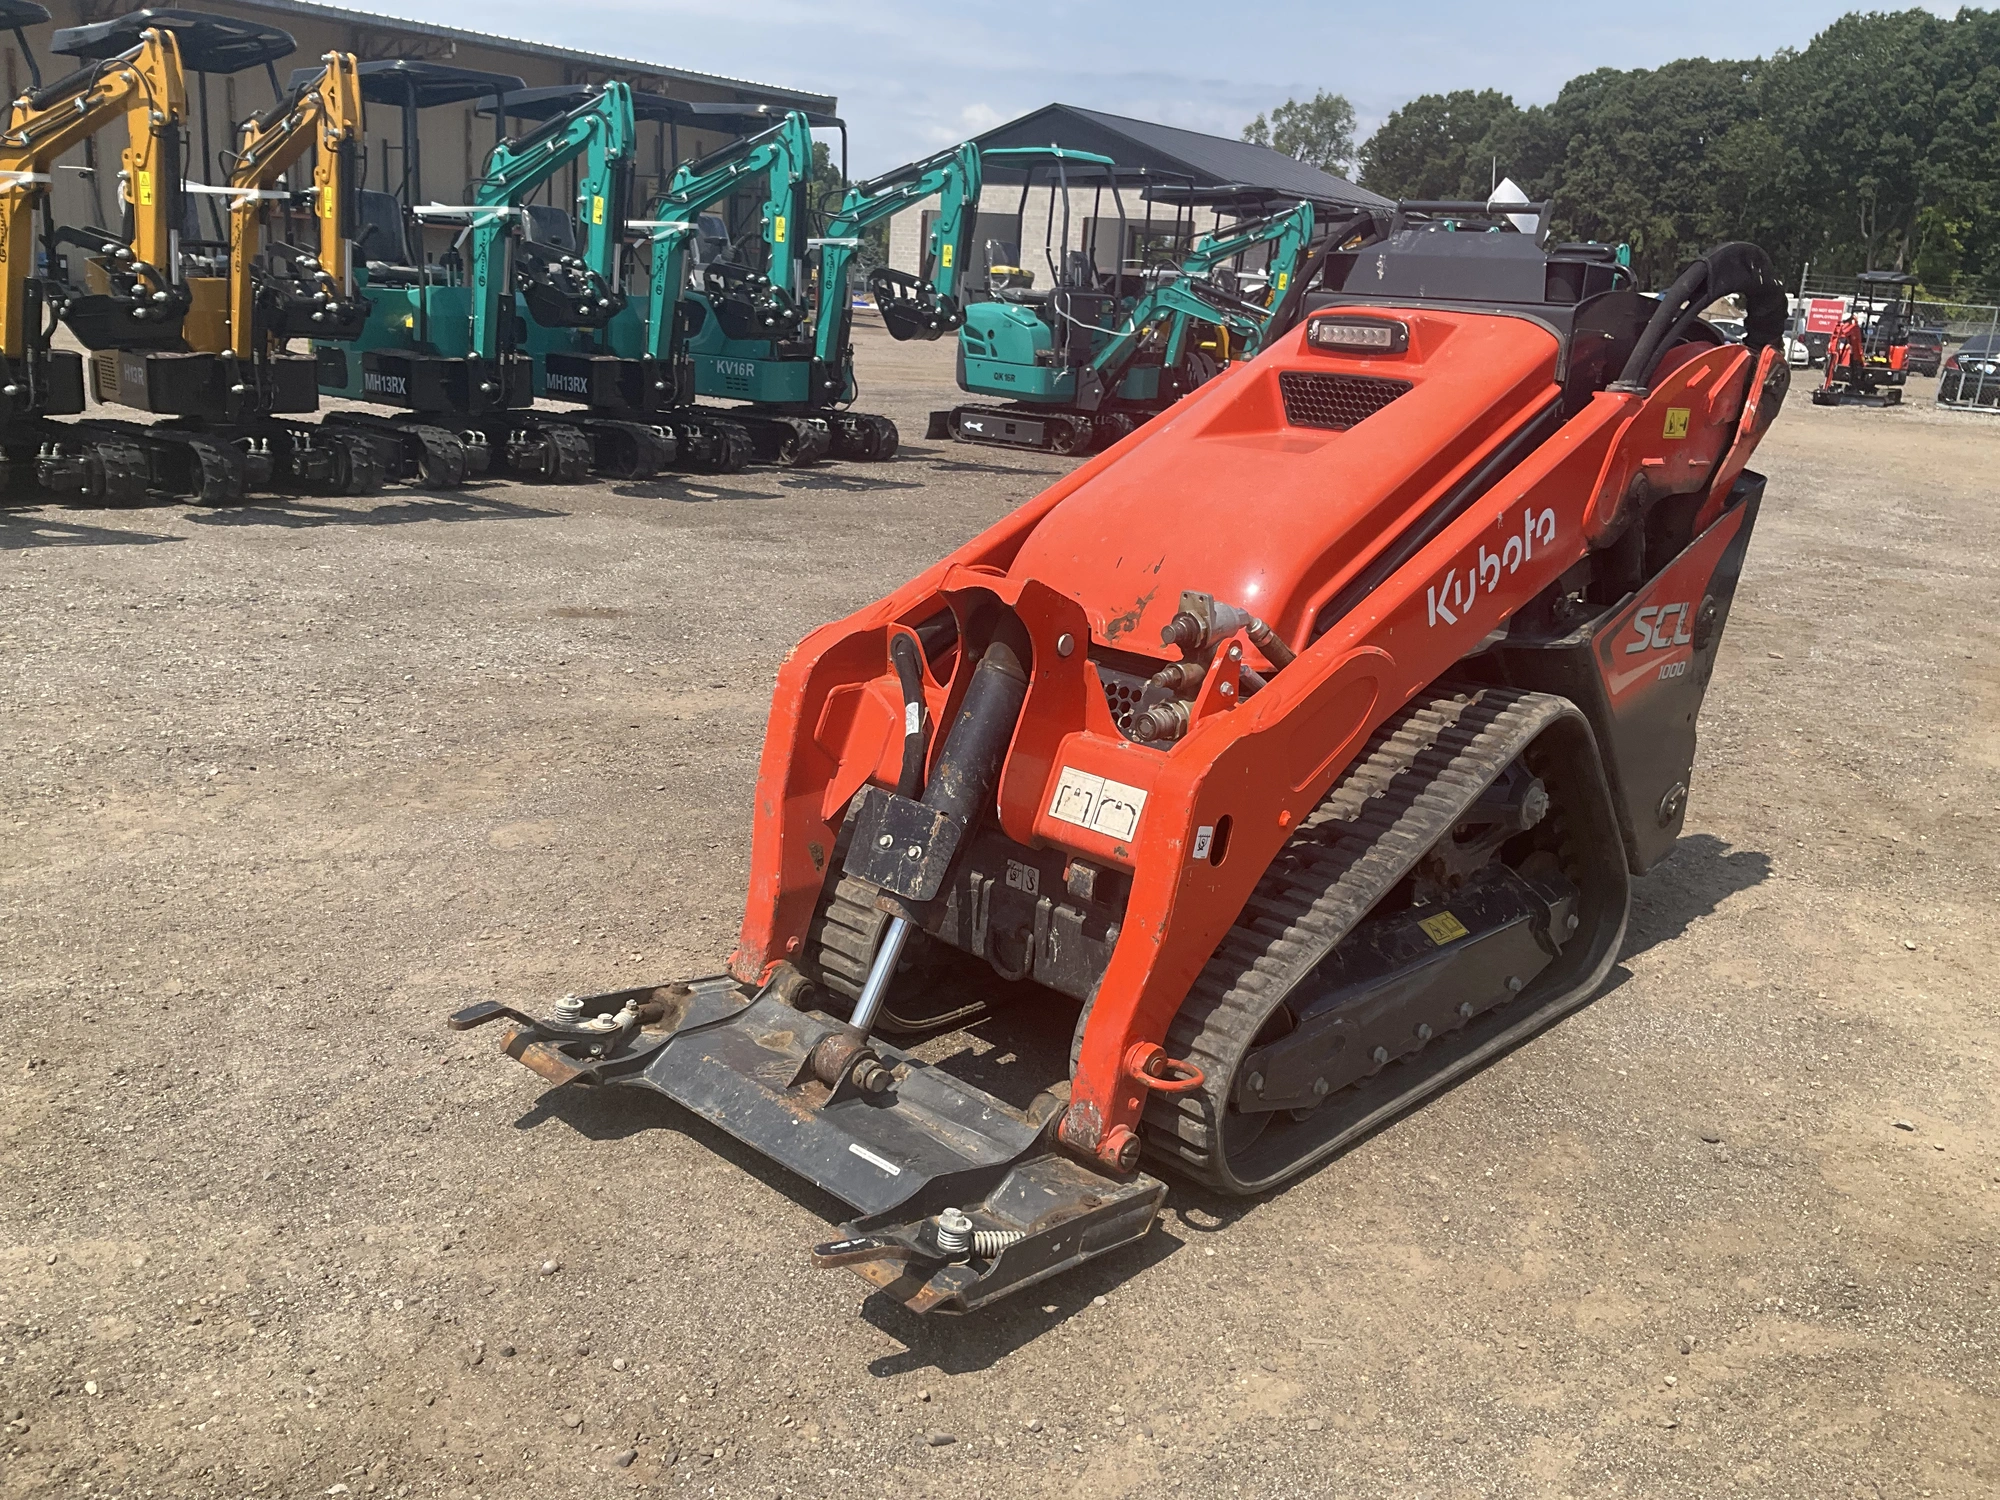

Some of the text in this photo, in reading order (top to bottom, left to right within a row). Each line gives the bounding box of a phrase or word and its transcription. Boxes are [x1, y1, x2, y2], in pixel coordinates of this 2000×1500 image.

[716, 359, 755, 377] KV16R
[364, 372, 407, 395] MH13RX
[546, 372, 588, 394] MH13RX
[1427, 507, 1556, 628] Kubota
[1625, 602, 1692, 654] SCL
[1657, 661, 1686, 681] 1000
